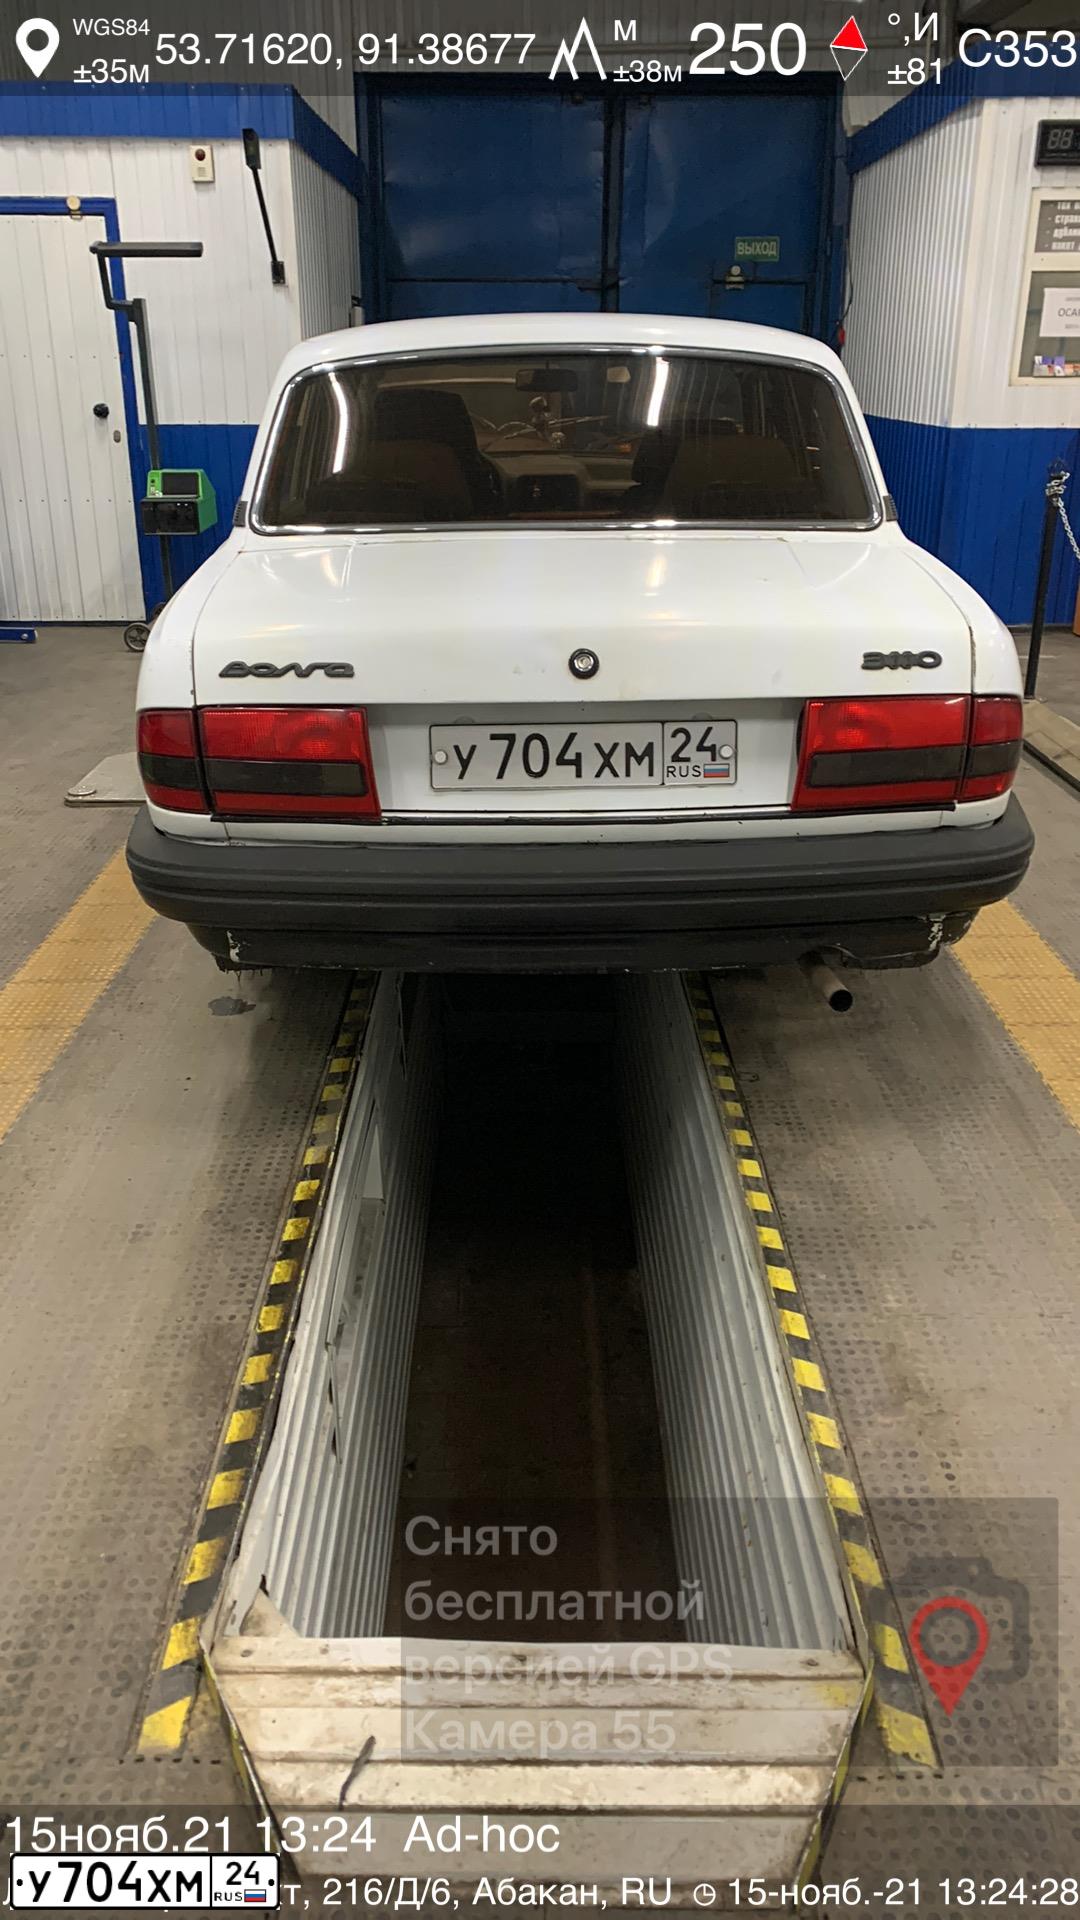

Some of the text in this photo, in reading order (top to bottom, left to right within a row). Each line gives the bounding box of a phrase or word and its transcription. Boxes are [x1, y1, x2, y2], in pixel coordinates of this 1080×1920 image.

[737, 241, 777, 256] ВЫХОД
[861, 650, 943, 670] 3110
[670, 726, 717, 763] 24
[666, 765, 701, 778] RUS
